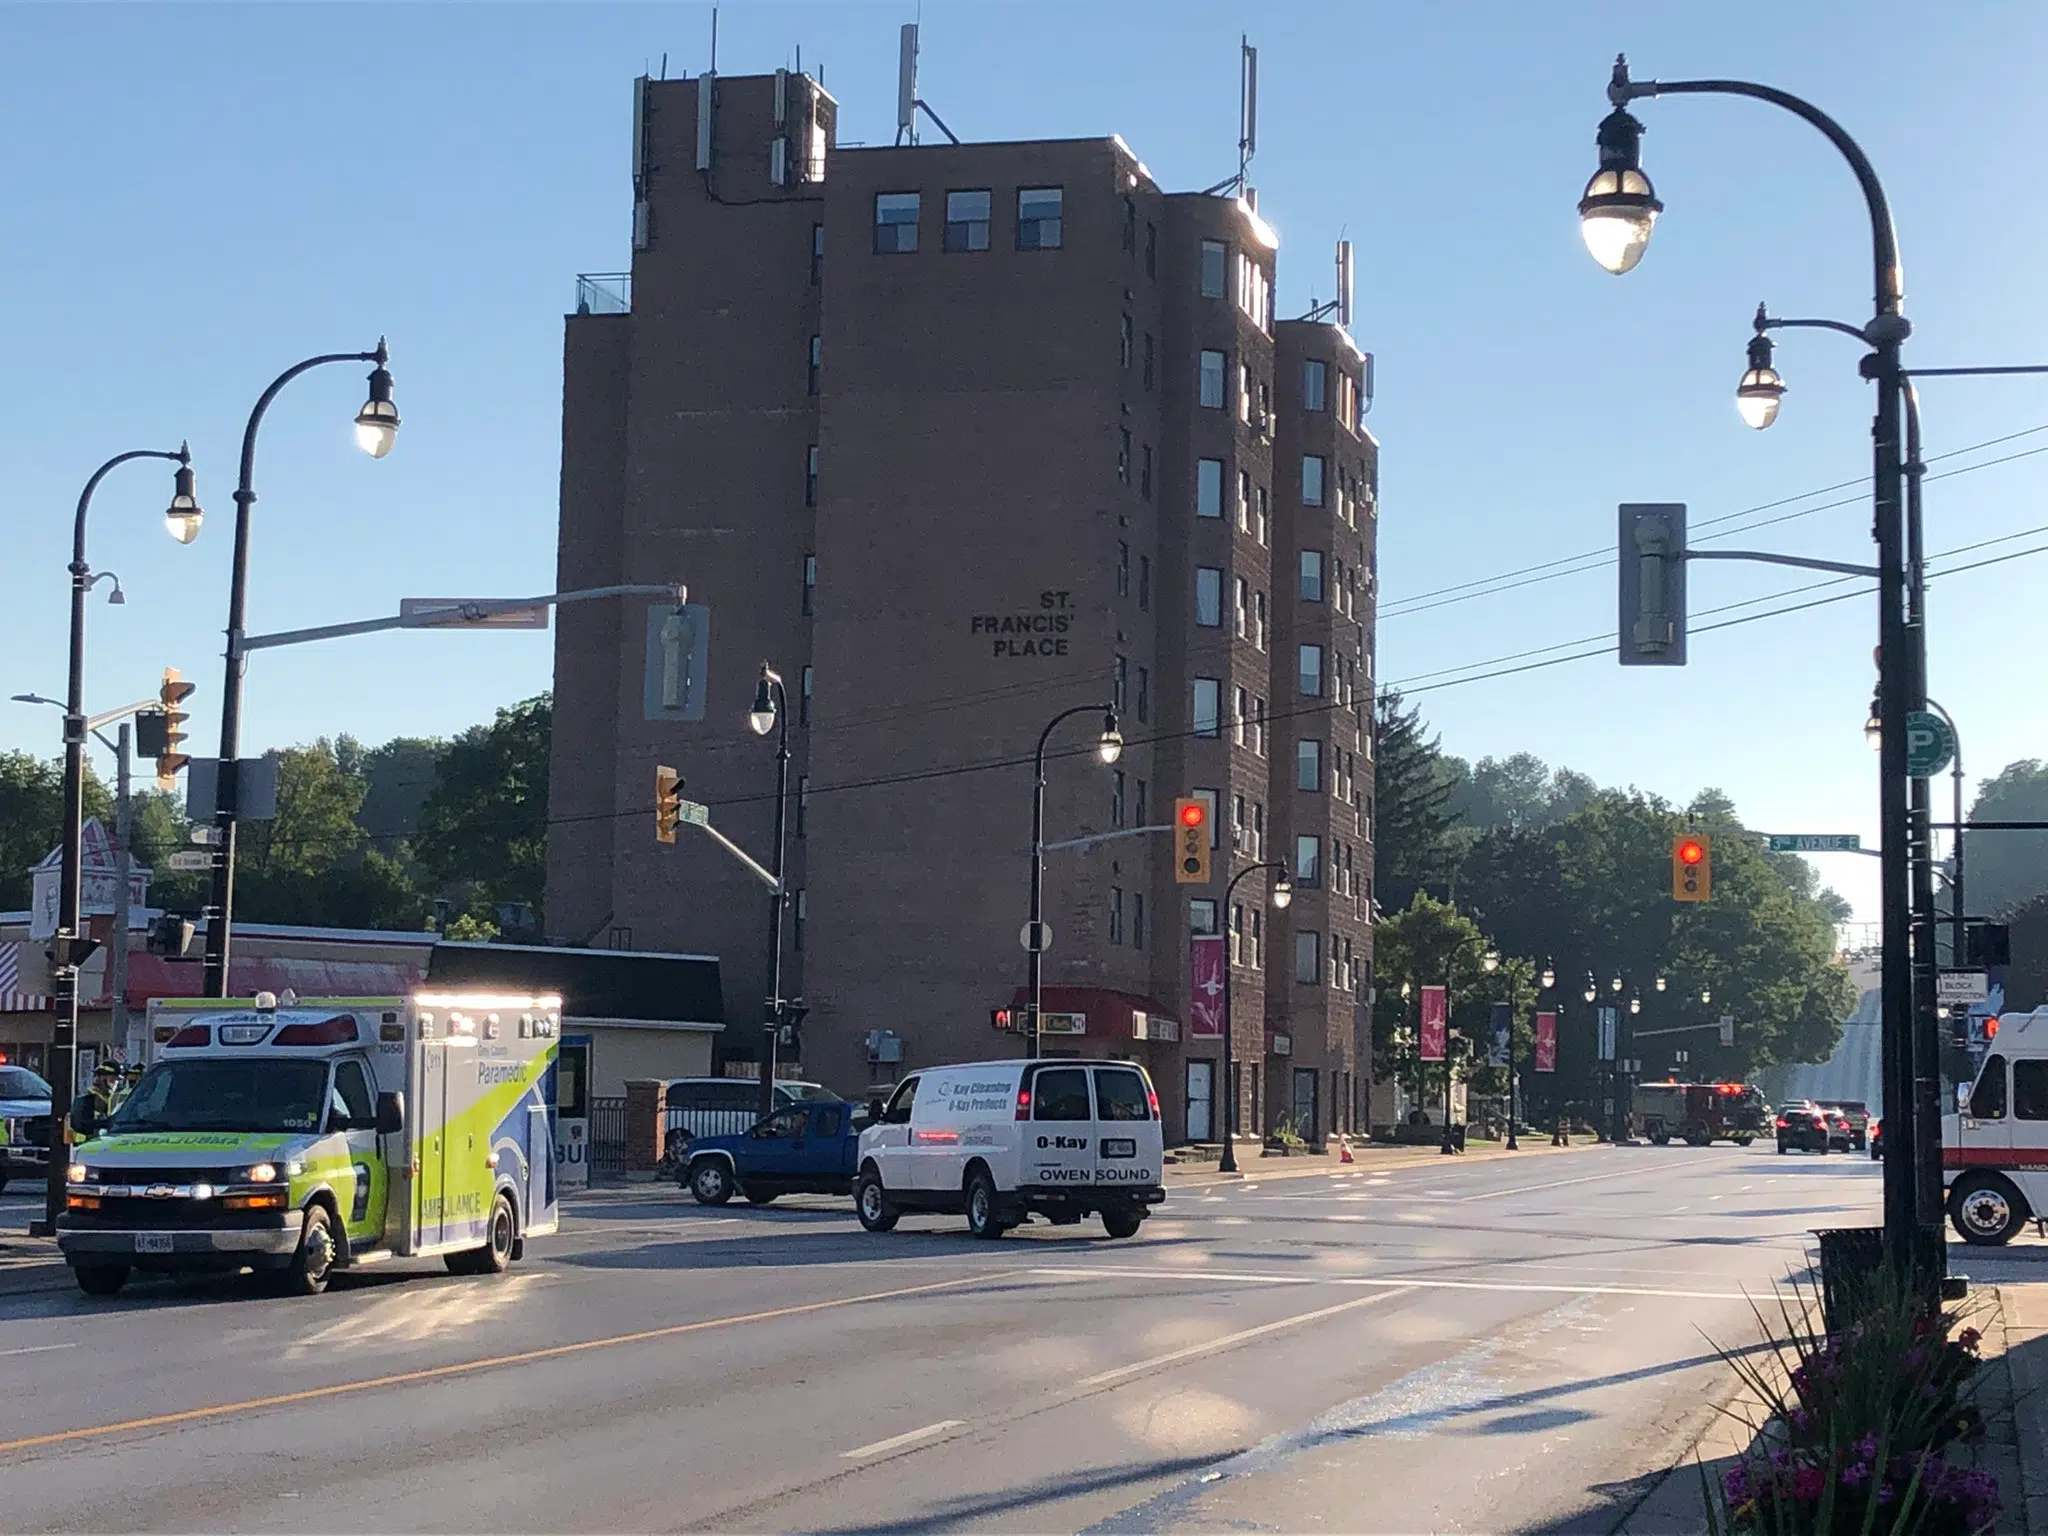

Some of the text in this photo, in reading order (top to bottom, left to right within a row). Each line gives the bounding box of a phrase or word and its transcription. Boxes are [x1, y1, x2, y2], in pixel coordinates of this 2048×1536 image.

[1040, 591, 1076, 609] ST.
[971, 614, 1075, 634] FRANCIS'
[993, 638, 1069, 657] PLACE
[1908, 730, 1934, 755] P
[1796, 836, 1844, 850] AVENUE
[1848, 836, 1858, 850] E
[1945, 982, 1973, 990] BLOCK
[379, 1043, 405, 1054] 1050
[477, 1061, 528, 1084] Paramedic
[971, 1098, 1008, 1111] Products
[283, 1118, 312, 1128] 1050
[1036, 1136, 1088, 1150] O-Kay
[1040, 1168, 1150, 1181] OWEN SOUND
[424, 1192, 481, 1219] AMBULANCE
